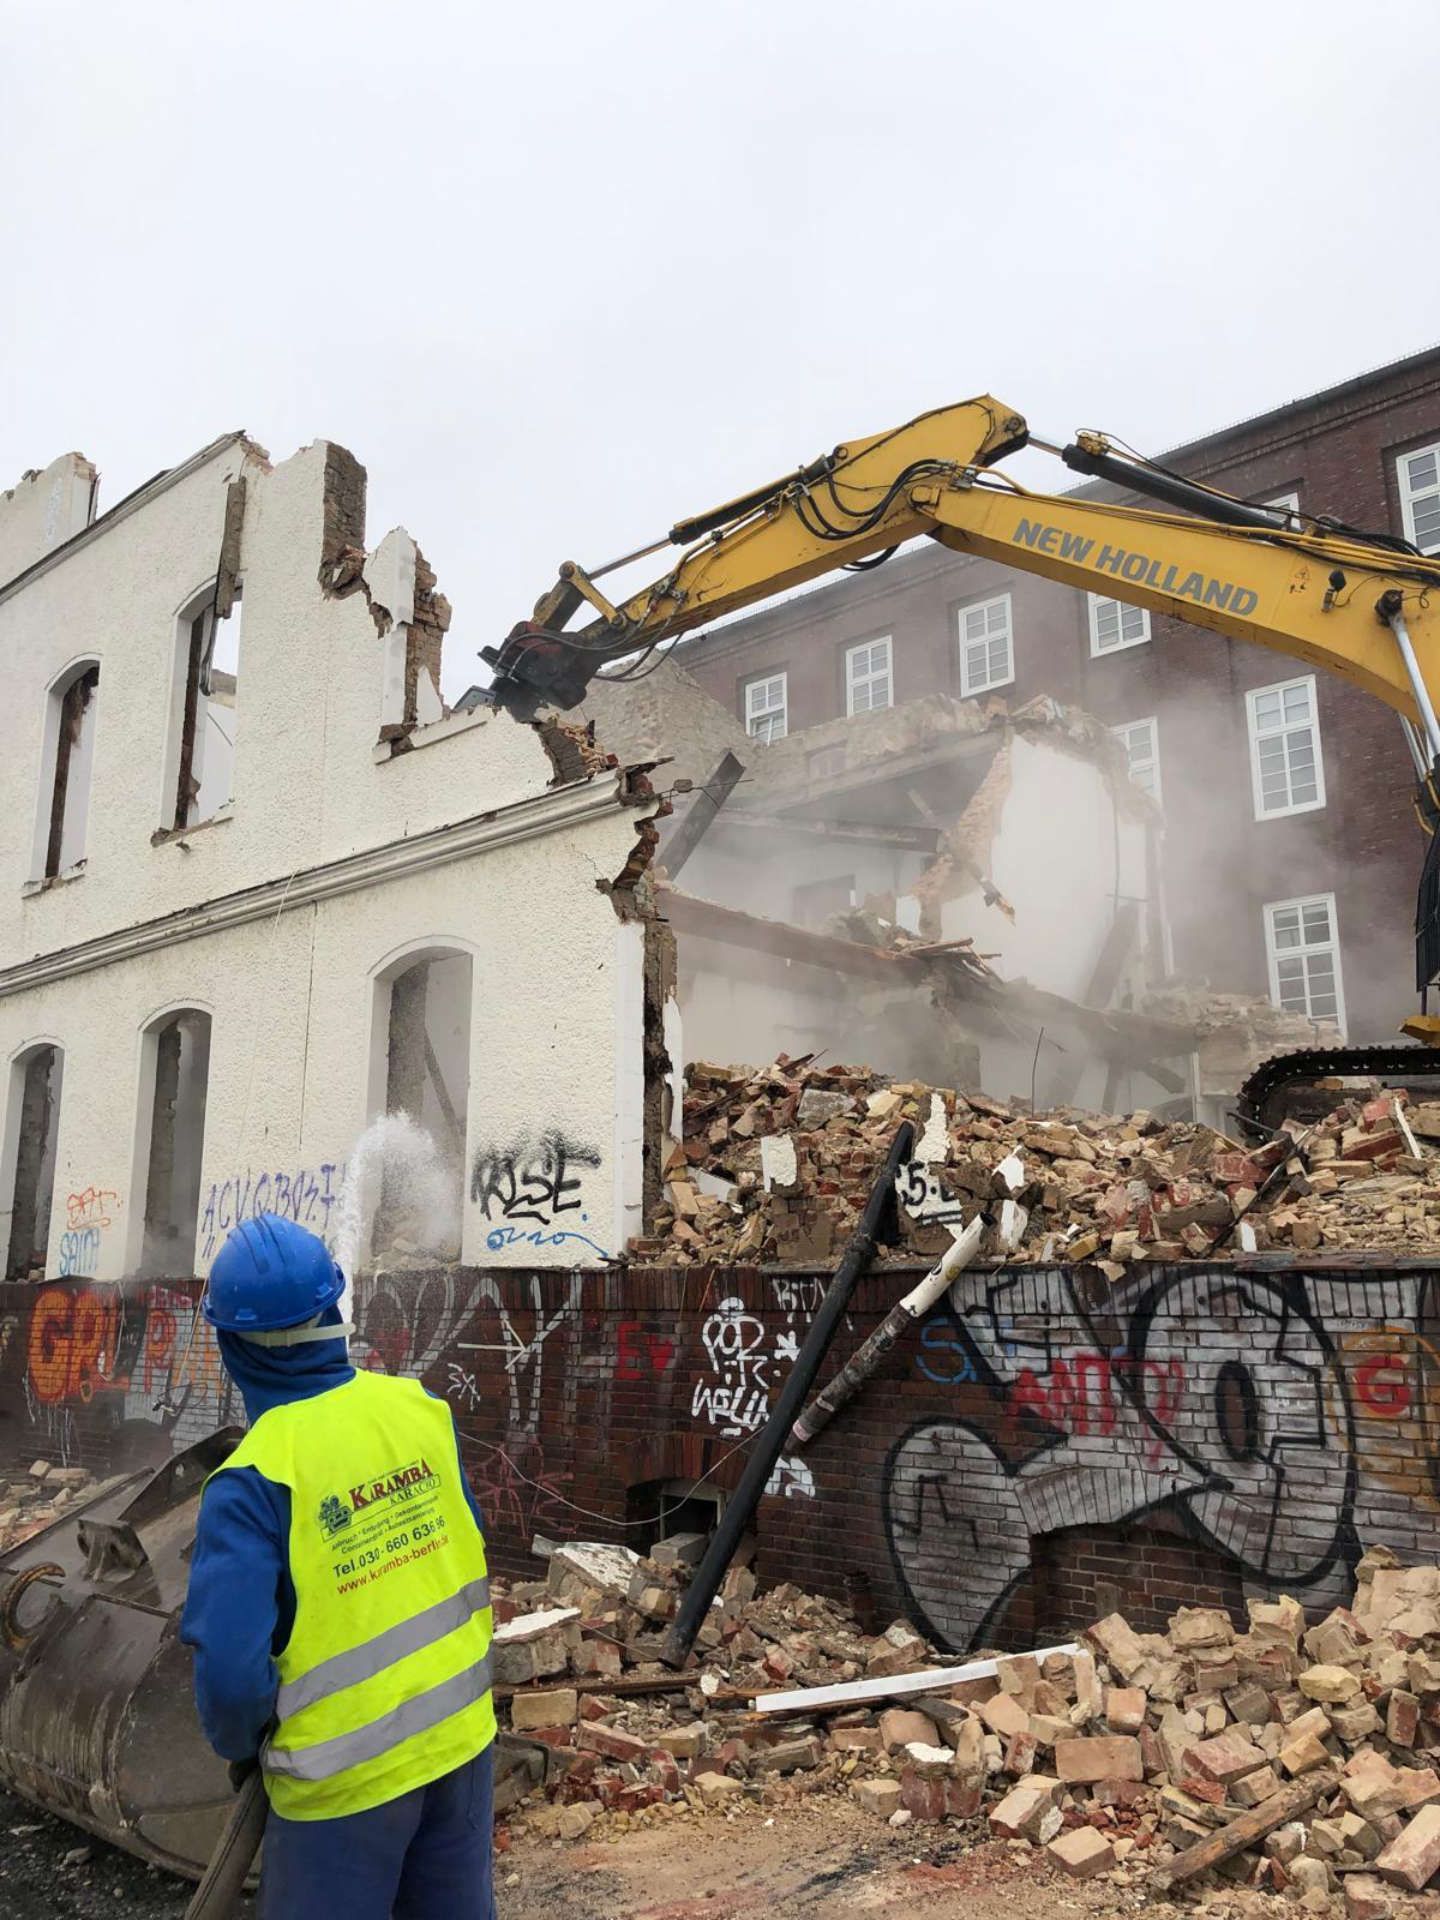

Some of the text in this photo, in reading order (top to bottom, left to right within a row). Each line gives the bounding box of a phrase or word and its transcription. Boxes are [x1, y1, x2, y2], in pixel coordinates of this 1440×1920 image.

[1012, 518, 1259, 617] NEW HOLLAND
[348, 1457, 433, 1511] KARAMBA
[386, 1533, 409, 1553] 660
